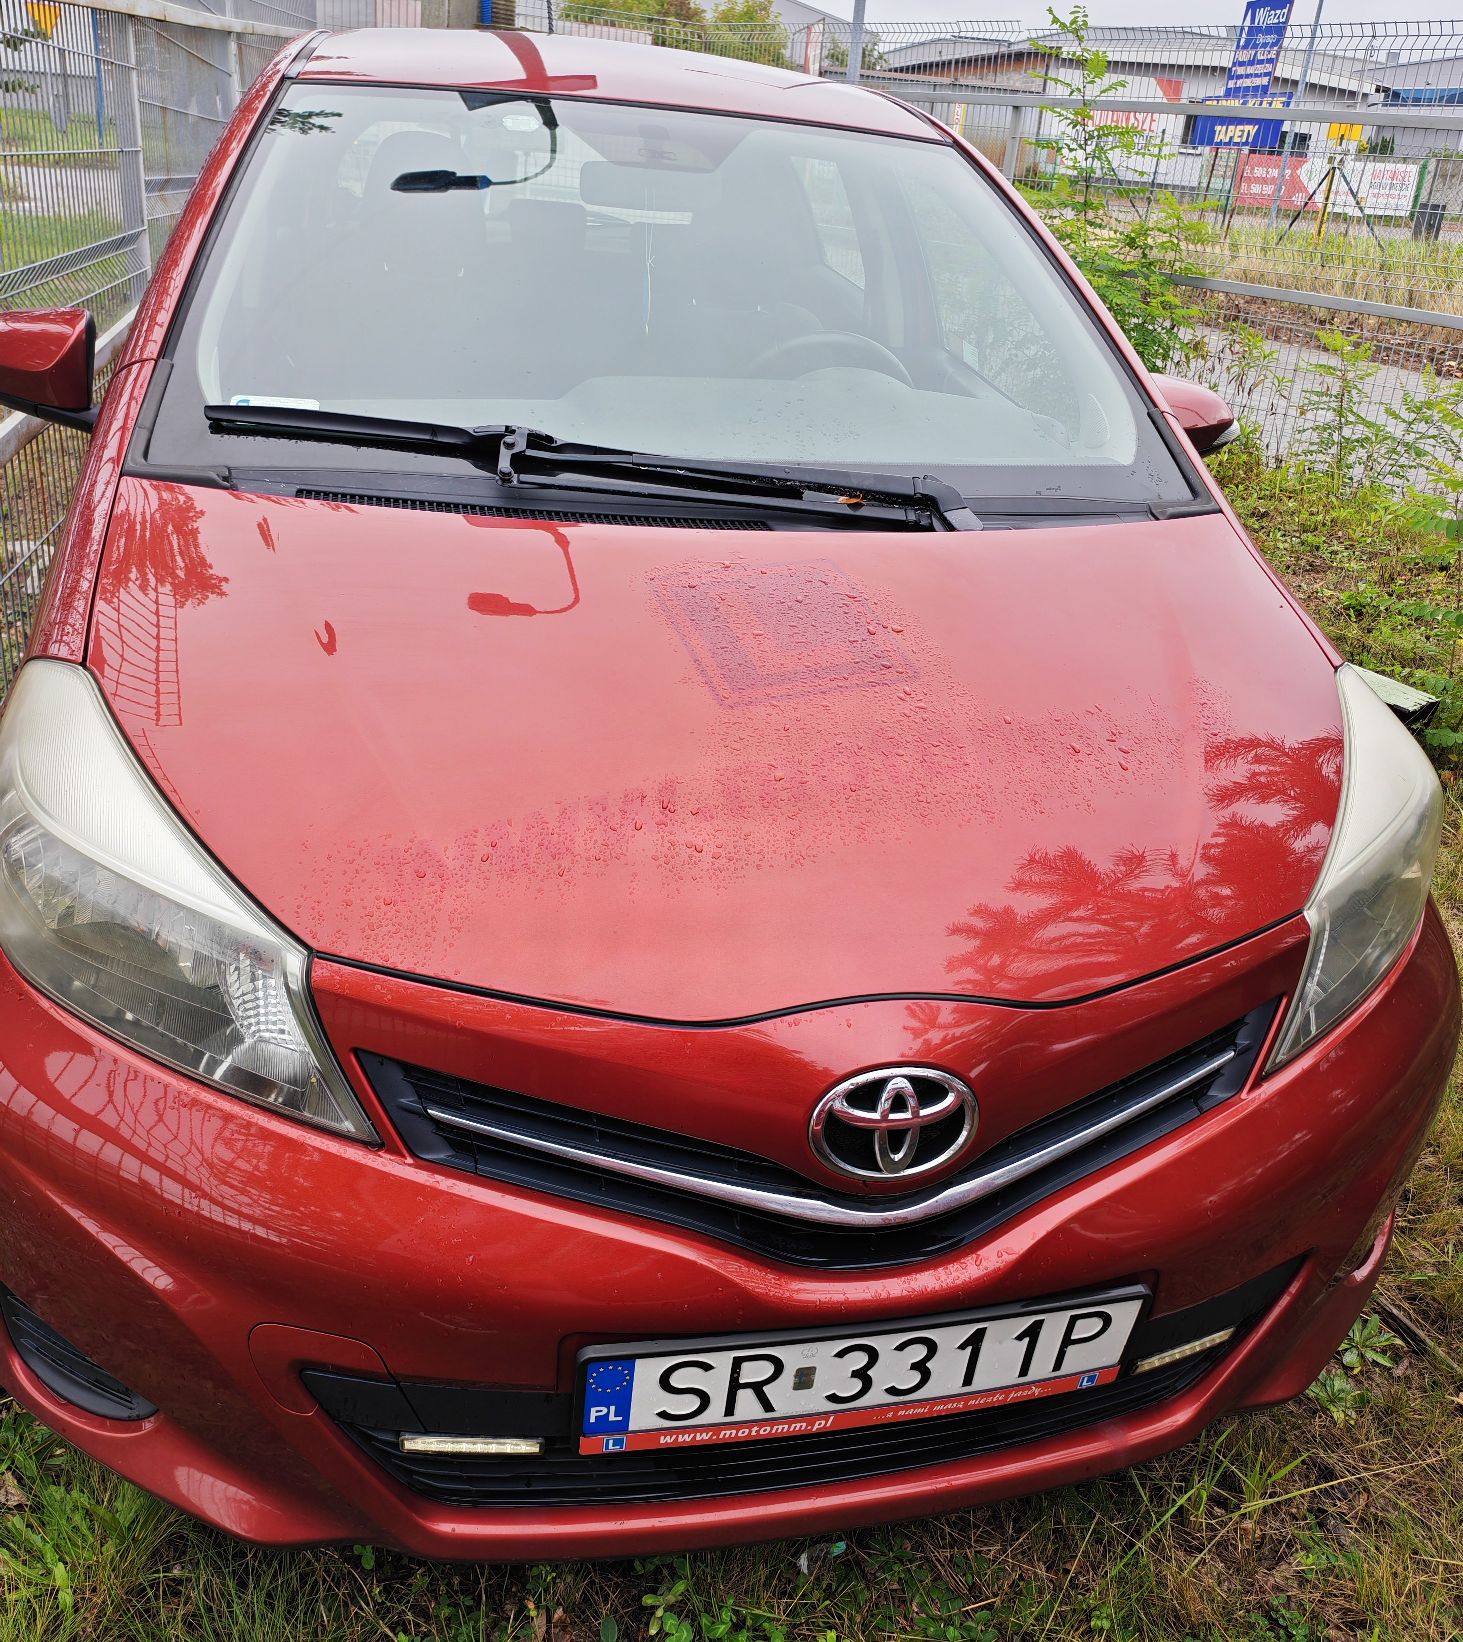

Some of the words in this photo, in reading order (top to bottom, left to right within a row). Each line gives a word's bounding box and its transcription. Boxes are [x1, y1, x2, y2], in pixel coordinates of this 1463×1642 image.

[1254, 4, 1289, 28] Wjazd
[1214, 125, 1259, 142] TAPETY
[655, 1353, 785, 1421] SR
[824, 1310, 1113, 1404] 3311P
[1081, 1375, 1093, 1386] L
[589, 1406, 623, 1423] PL
[897, 1405, 930, 1416] nami
[932, 1401, 965, 1411] masz
[659, 1416, 835, 1444] www.motomm.pl
[608, 1438, 621, 1450] L
